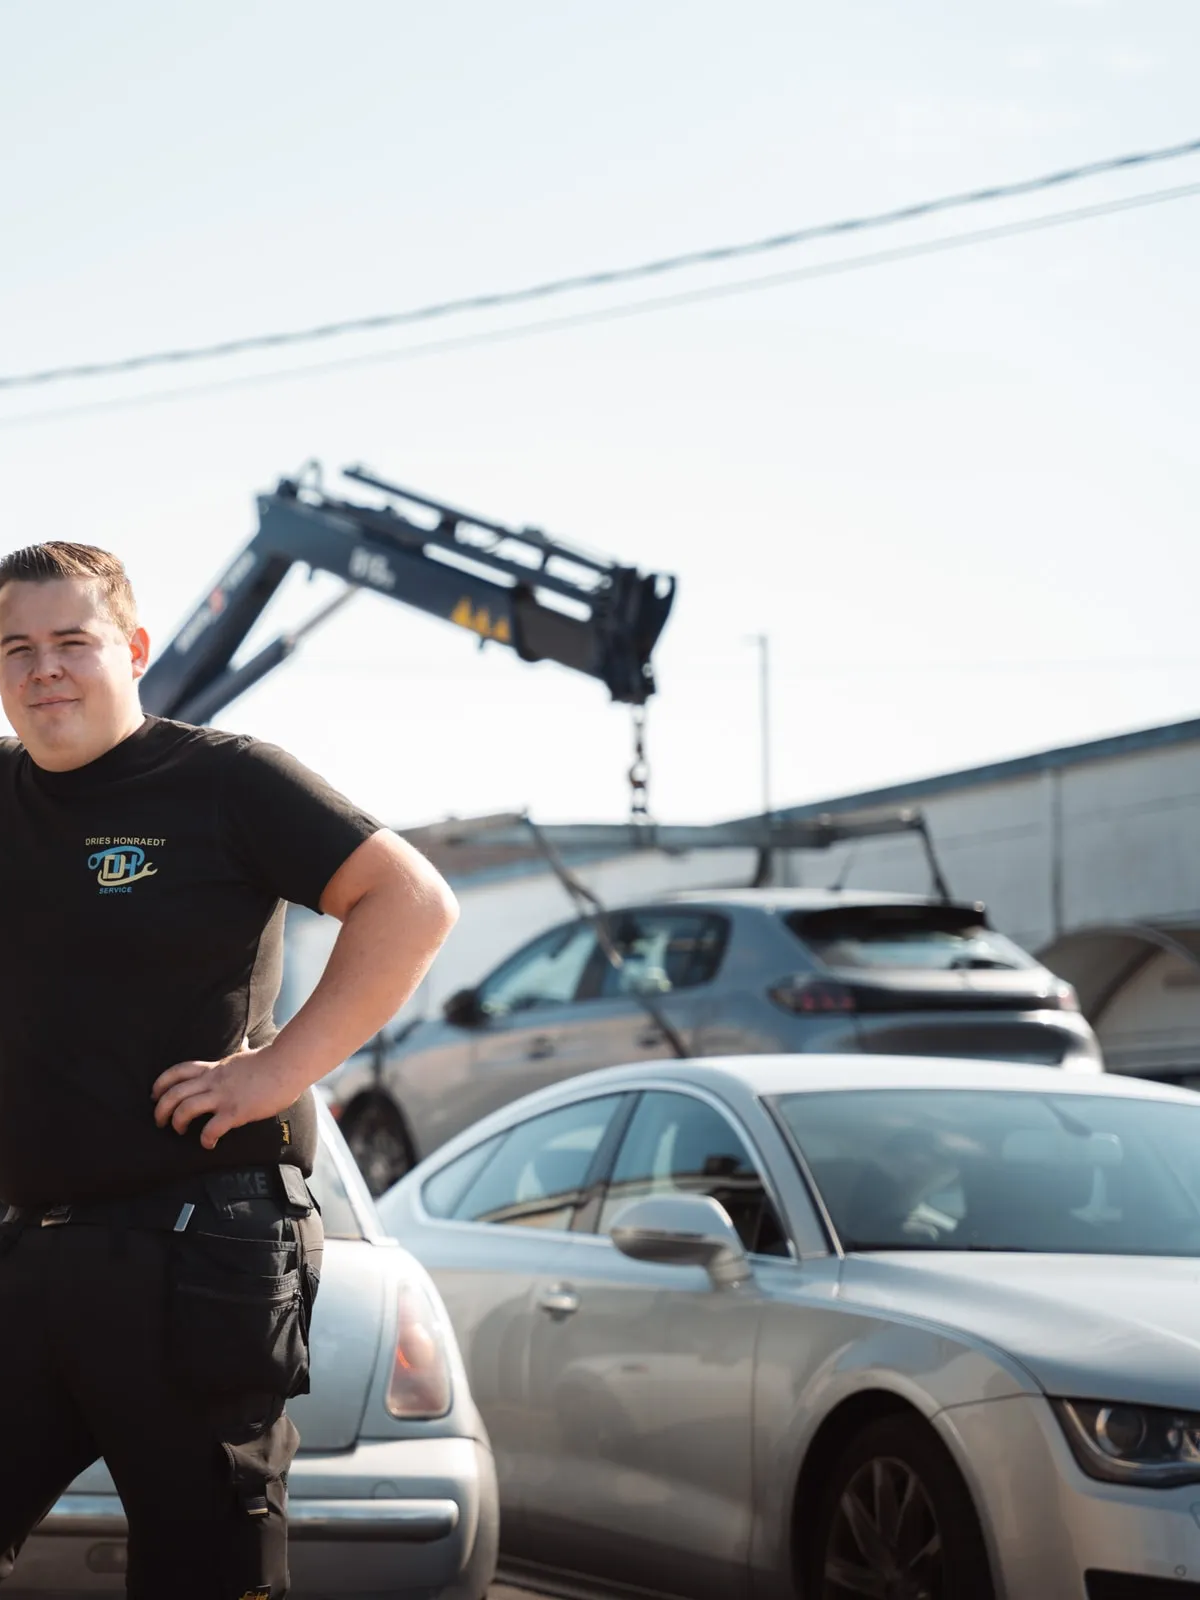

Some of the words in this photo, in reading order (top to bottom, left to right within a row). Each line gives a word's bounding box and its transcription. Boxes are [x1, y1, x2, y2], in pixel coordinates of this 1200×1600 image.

[85, 837, 111, 846] DRIES
[113, 837, 166, 846] HONRAEDT
[102, 853, 138, 880] DH
[98, 886, 133, 895] SERVICE
